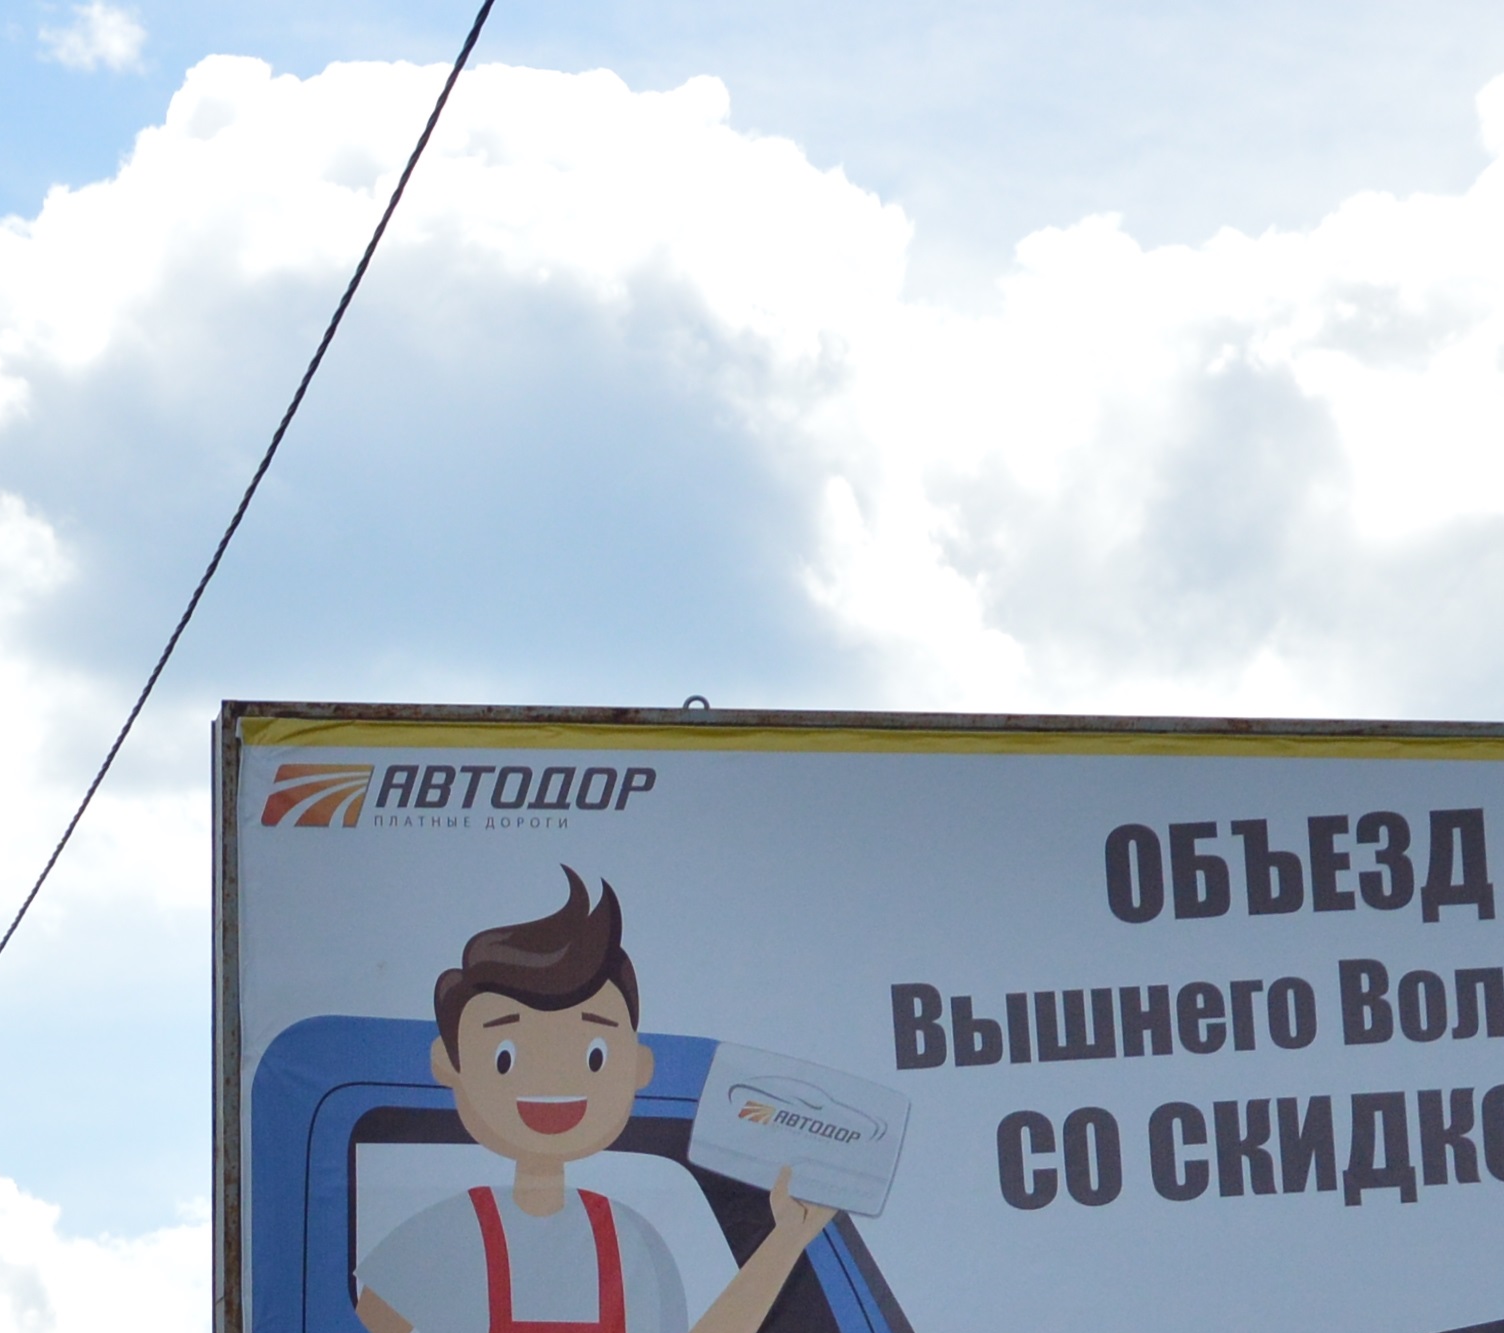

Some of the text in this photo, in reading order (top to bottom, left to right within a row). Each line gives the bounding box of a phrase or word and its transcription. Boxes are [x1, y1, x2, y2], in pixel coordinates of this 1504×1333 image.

[373, 814, 569, 830] ПЛАТНЫЕ ДОРОГИ
[375, 764, 658, 811] АВТОДОР
[1104, 807, 1496, 924] ОБЪЕЗД
[890, 975, 1318, 1070] Вышнего
[773, 1109, 862, 1144] АВТОДОР
[995, 1106, 1123, 1211] СО
